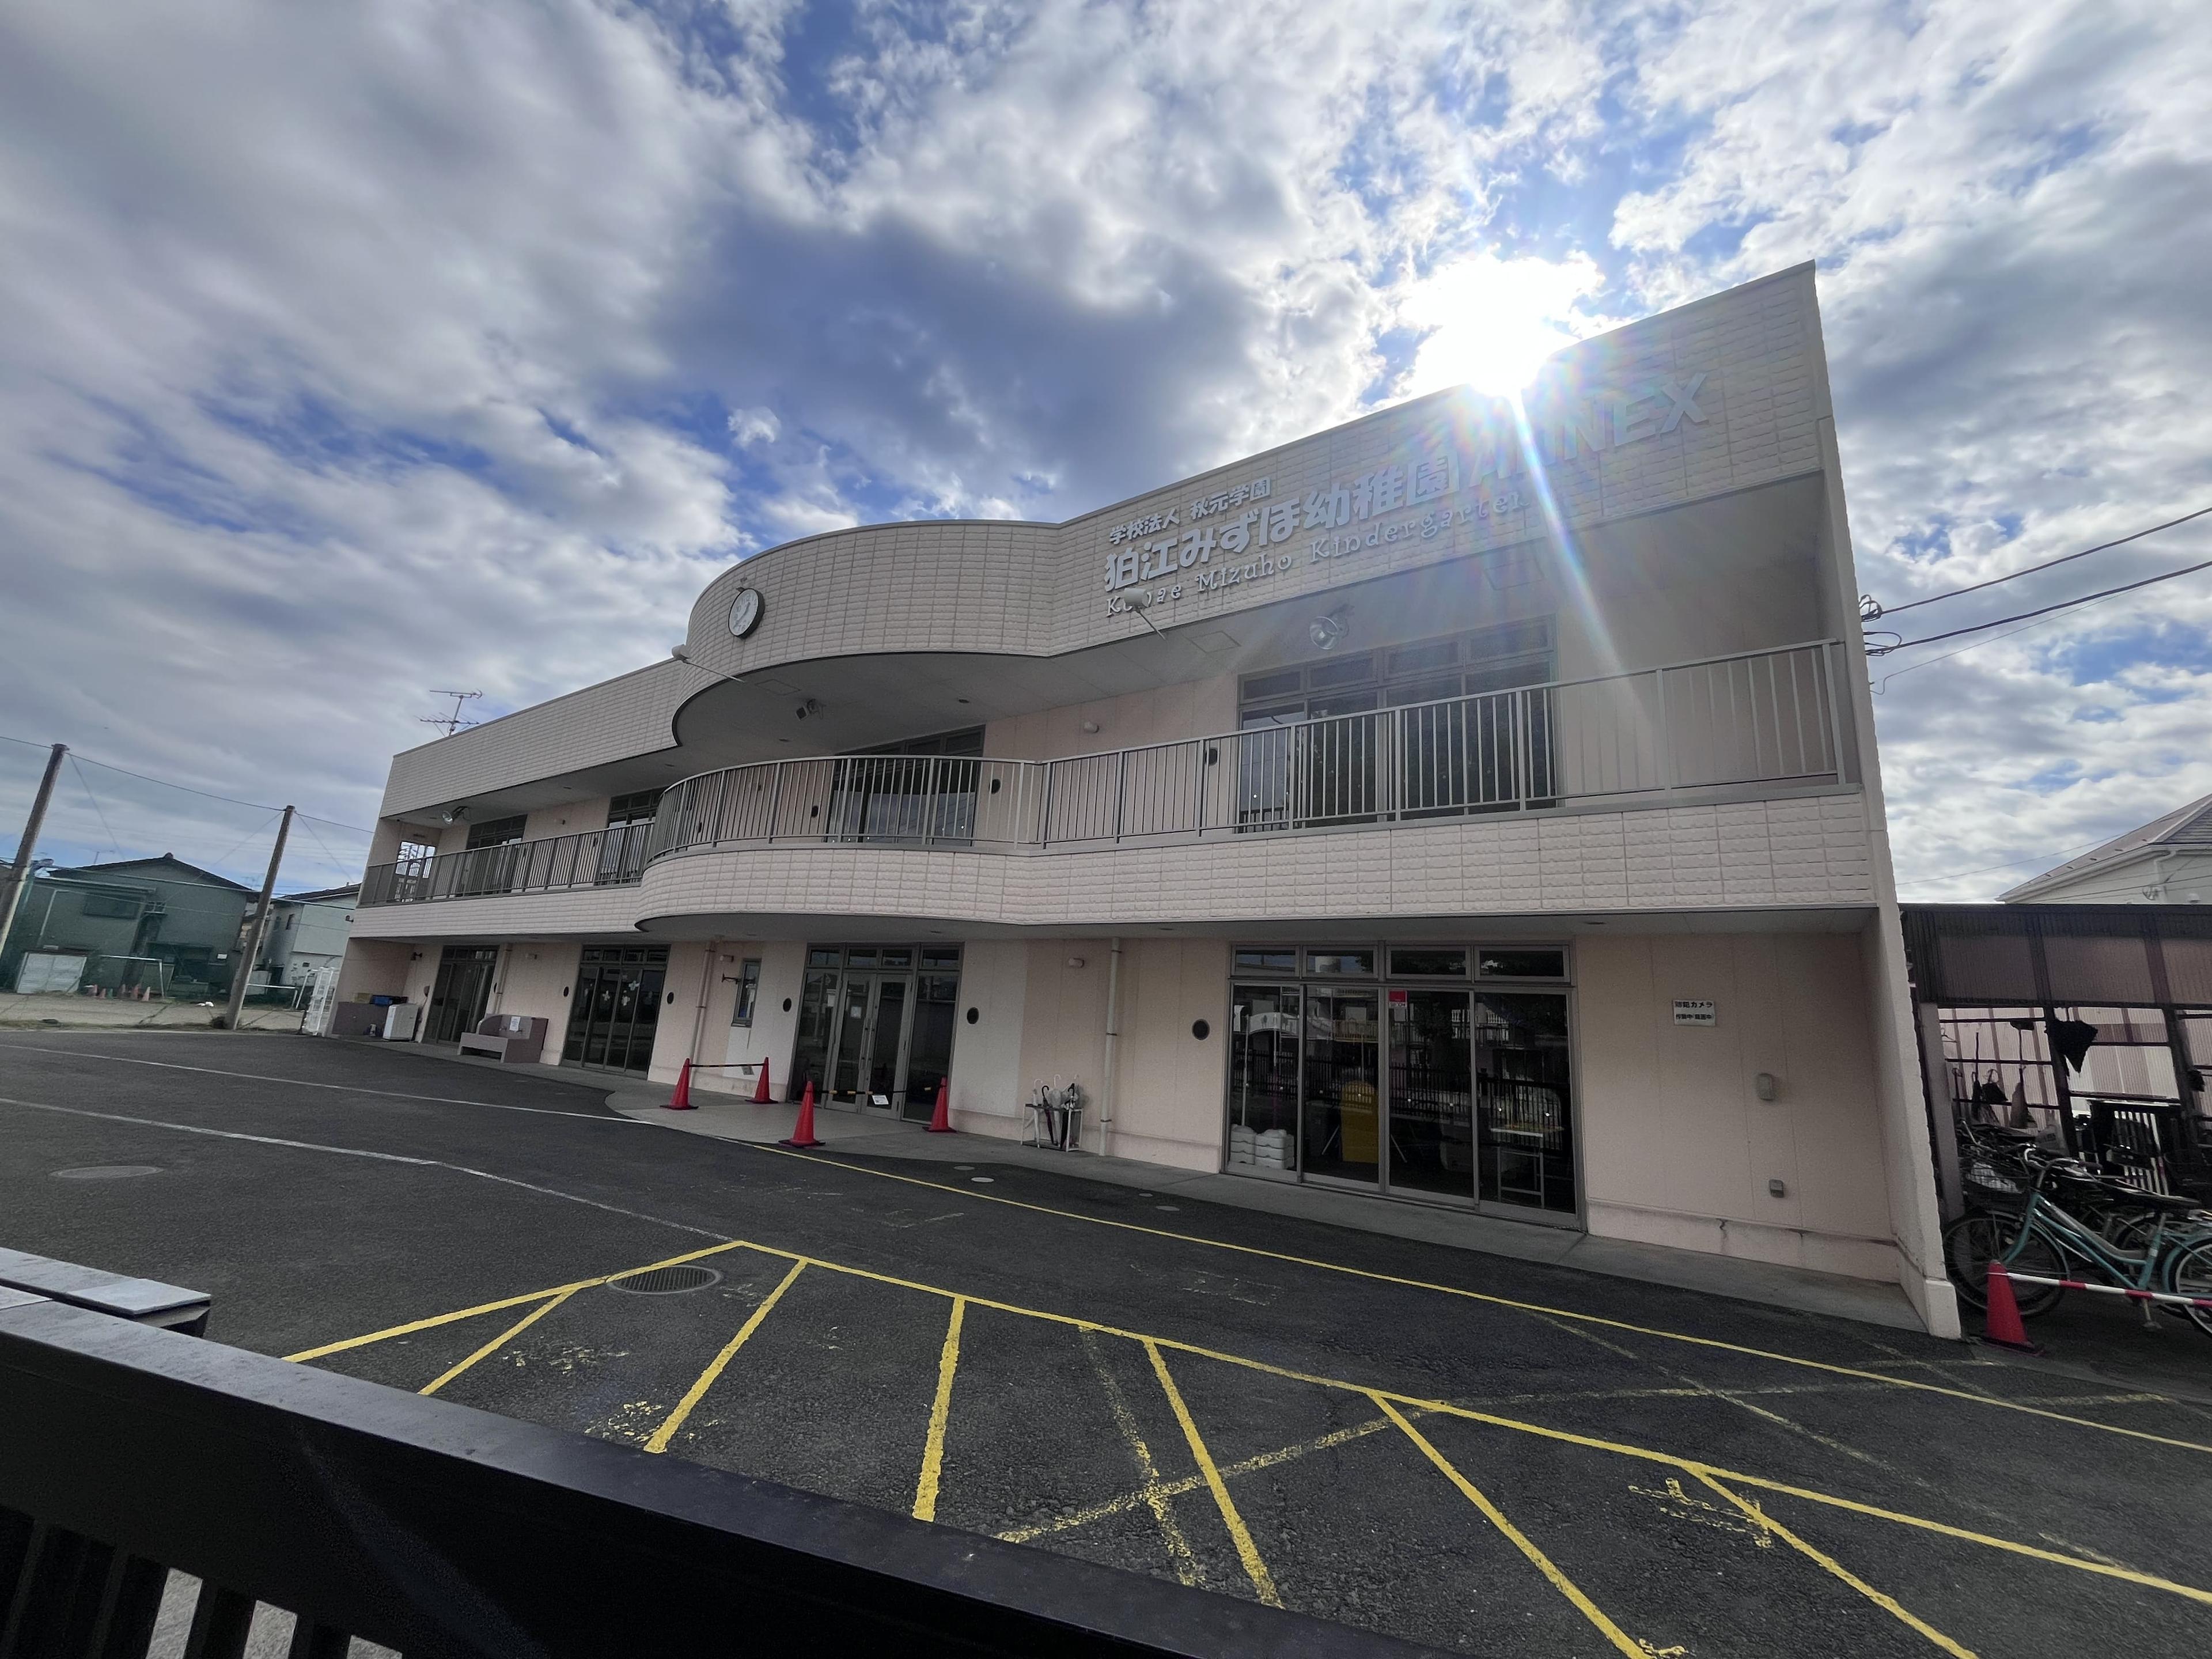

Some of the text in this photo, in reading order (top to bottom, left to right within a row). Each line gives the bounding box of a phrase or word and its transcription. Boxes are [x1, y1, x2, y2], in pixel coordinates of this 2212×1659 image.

[1104, 373, 1710, 592] 狛江みずほ幼稚園 ANEX
[1109, 477, 1271, 545] 学校法人 秋元学園
[1106, 585, 1182, 618] Kae
[1194, 553, 1293, 592] Mizuho
